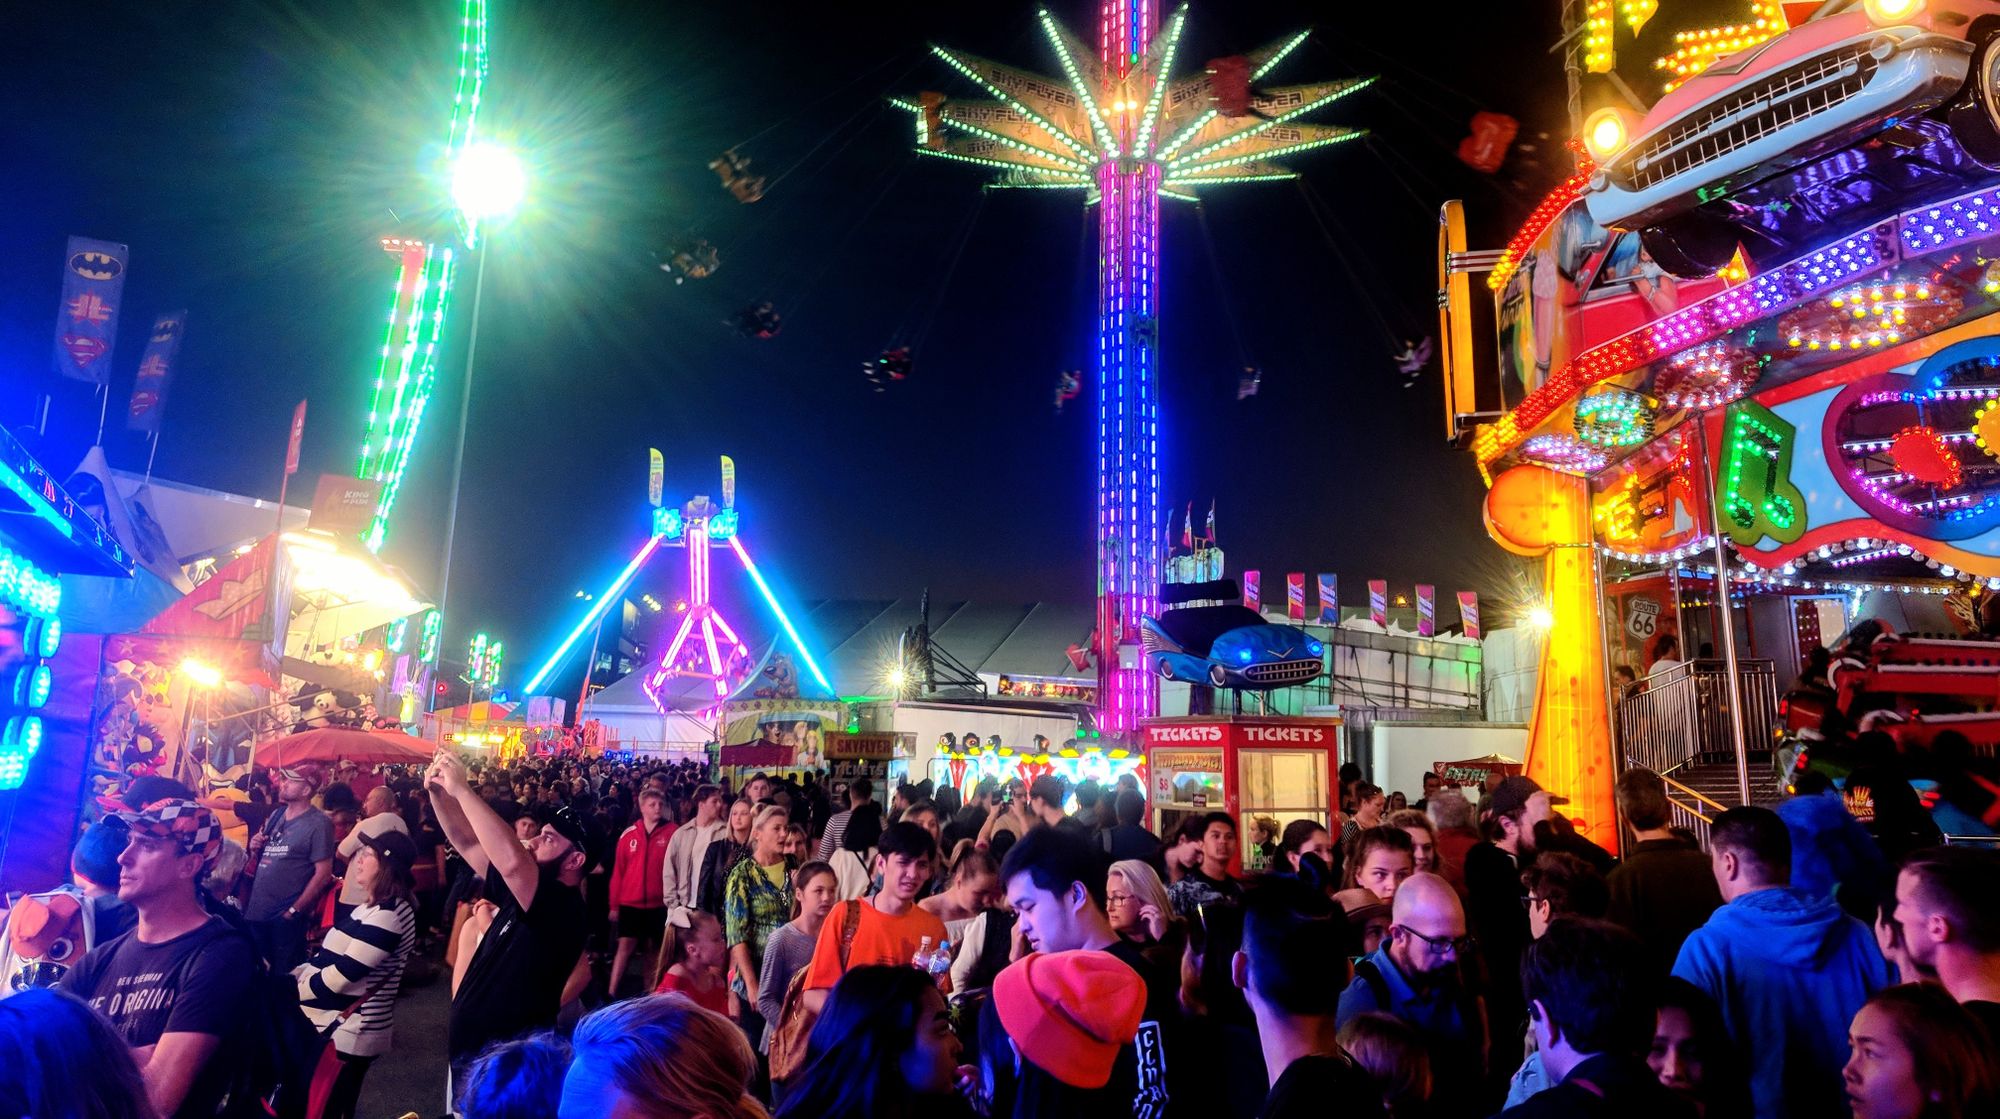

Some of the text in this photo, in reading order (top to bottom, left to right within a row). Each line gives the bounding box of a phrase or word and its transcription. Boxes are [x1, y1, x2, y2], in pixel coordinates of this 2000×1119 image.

[1026, 81, 1077, 108] FLYER
[1256, 92, 1303, 109] LYER
[1260, 127, 1302, 141] LYER
[1634, 601, 1657, 613] ROUTE
[1633, 613, 1654, 635] 66
[1150, 726, 1223, 742] TICKETS
[1243, 727, 1324, 742] TICKETS
[837, 739, 891, 754] SKYFLYER
[833, 764, 885, 776] TICKETS
[109, 987, 175, 1015] ORIGINA
